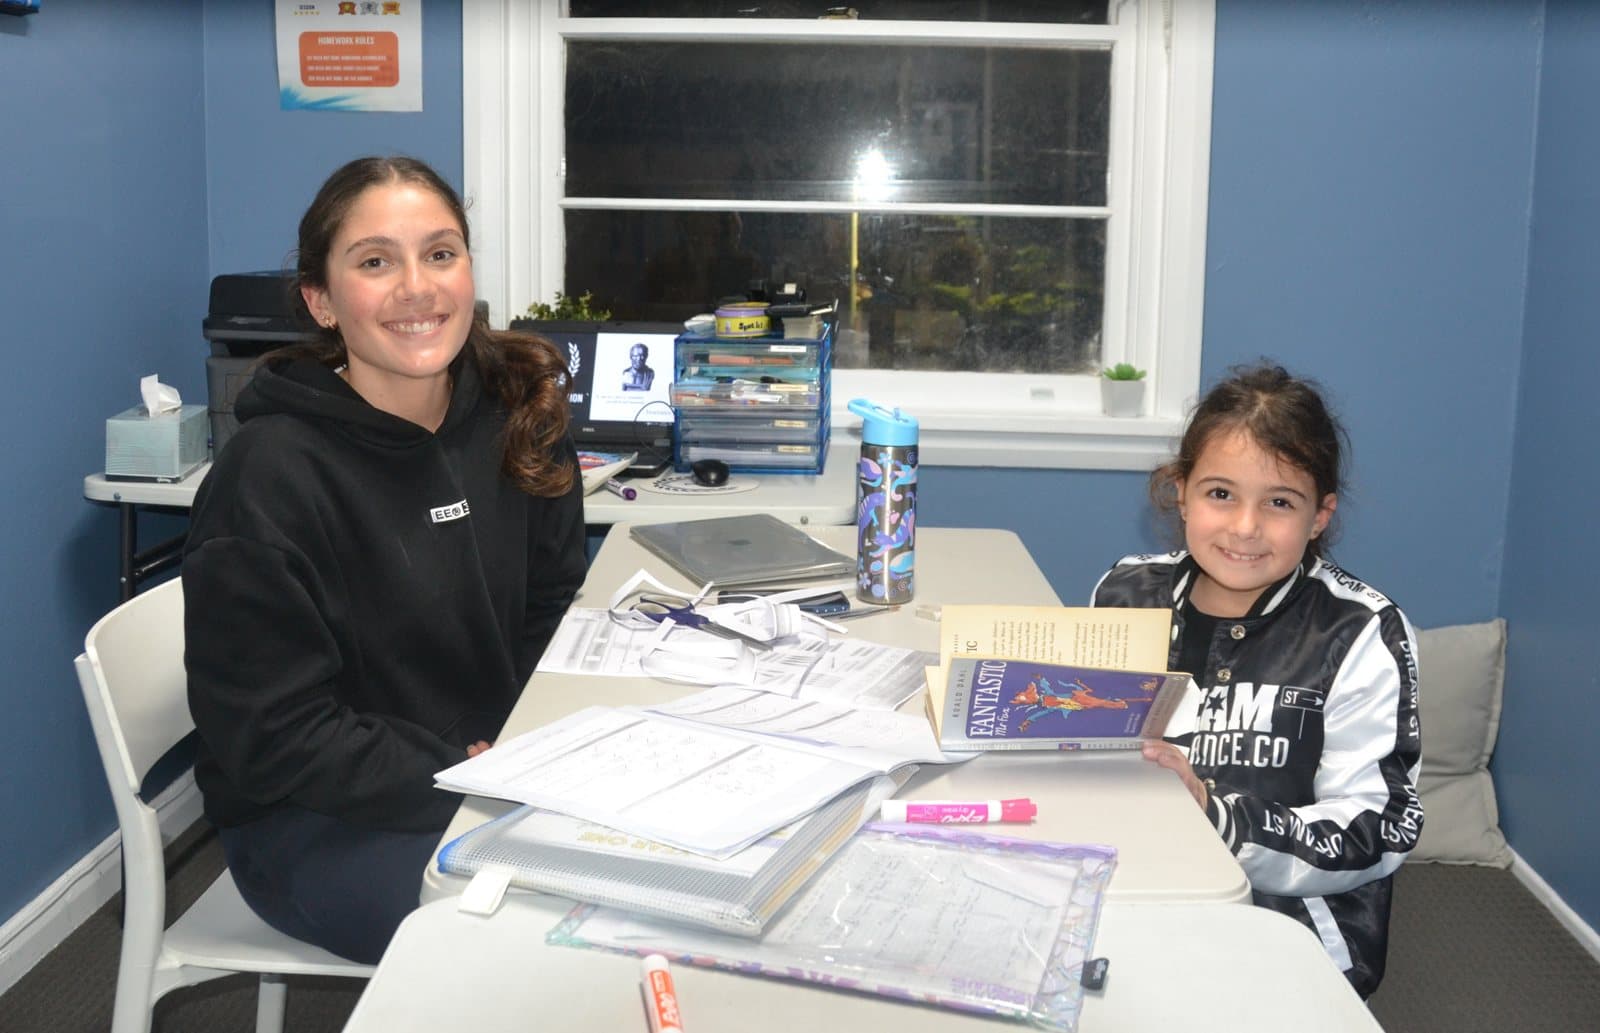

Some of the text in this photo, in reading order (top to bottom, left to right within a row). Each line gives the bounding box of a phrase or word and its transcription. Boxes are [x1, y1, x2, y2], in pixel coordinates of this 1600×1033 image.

[318, 36, 375, 45] HOMEWORK RULES
[739, 321, 755, 331] Spot
[952, 691, 963, 718] ROALD
[969, 660, 1008, 737] FANTASTIC
[1284, 690, 1299, 705] ST
[1262, 809, 1285, 836] ST
